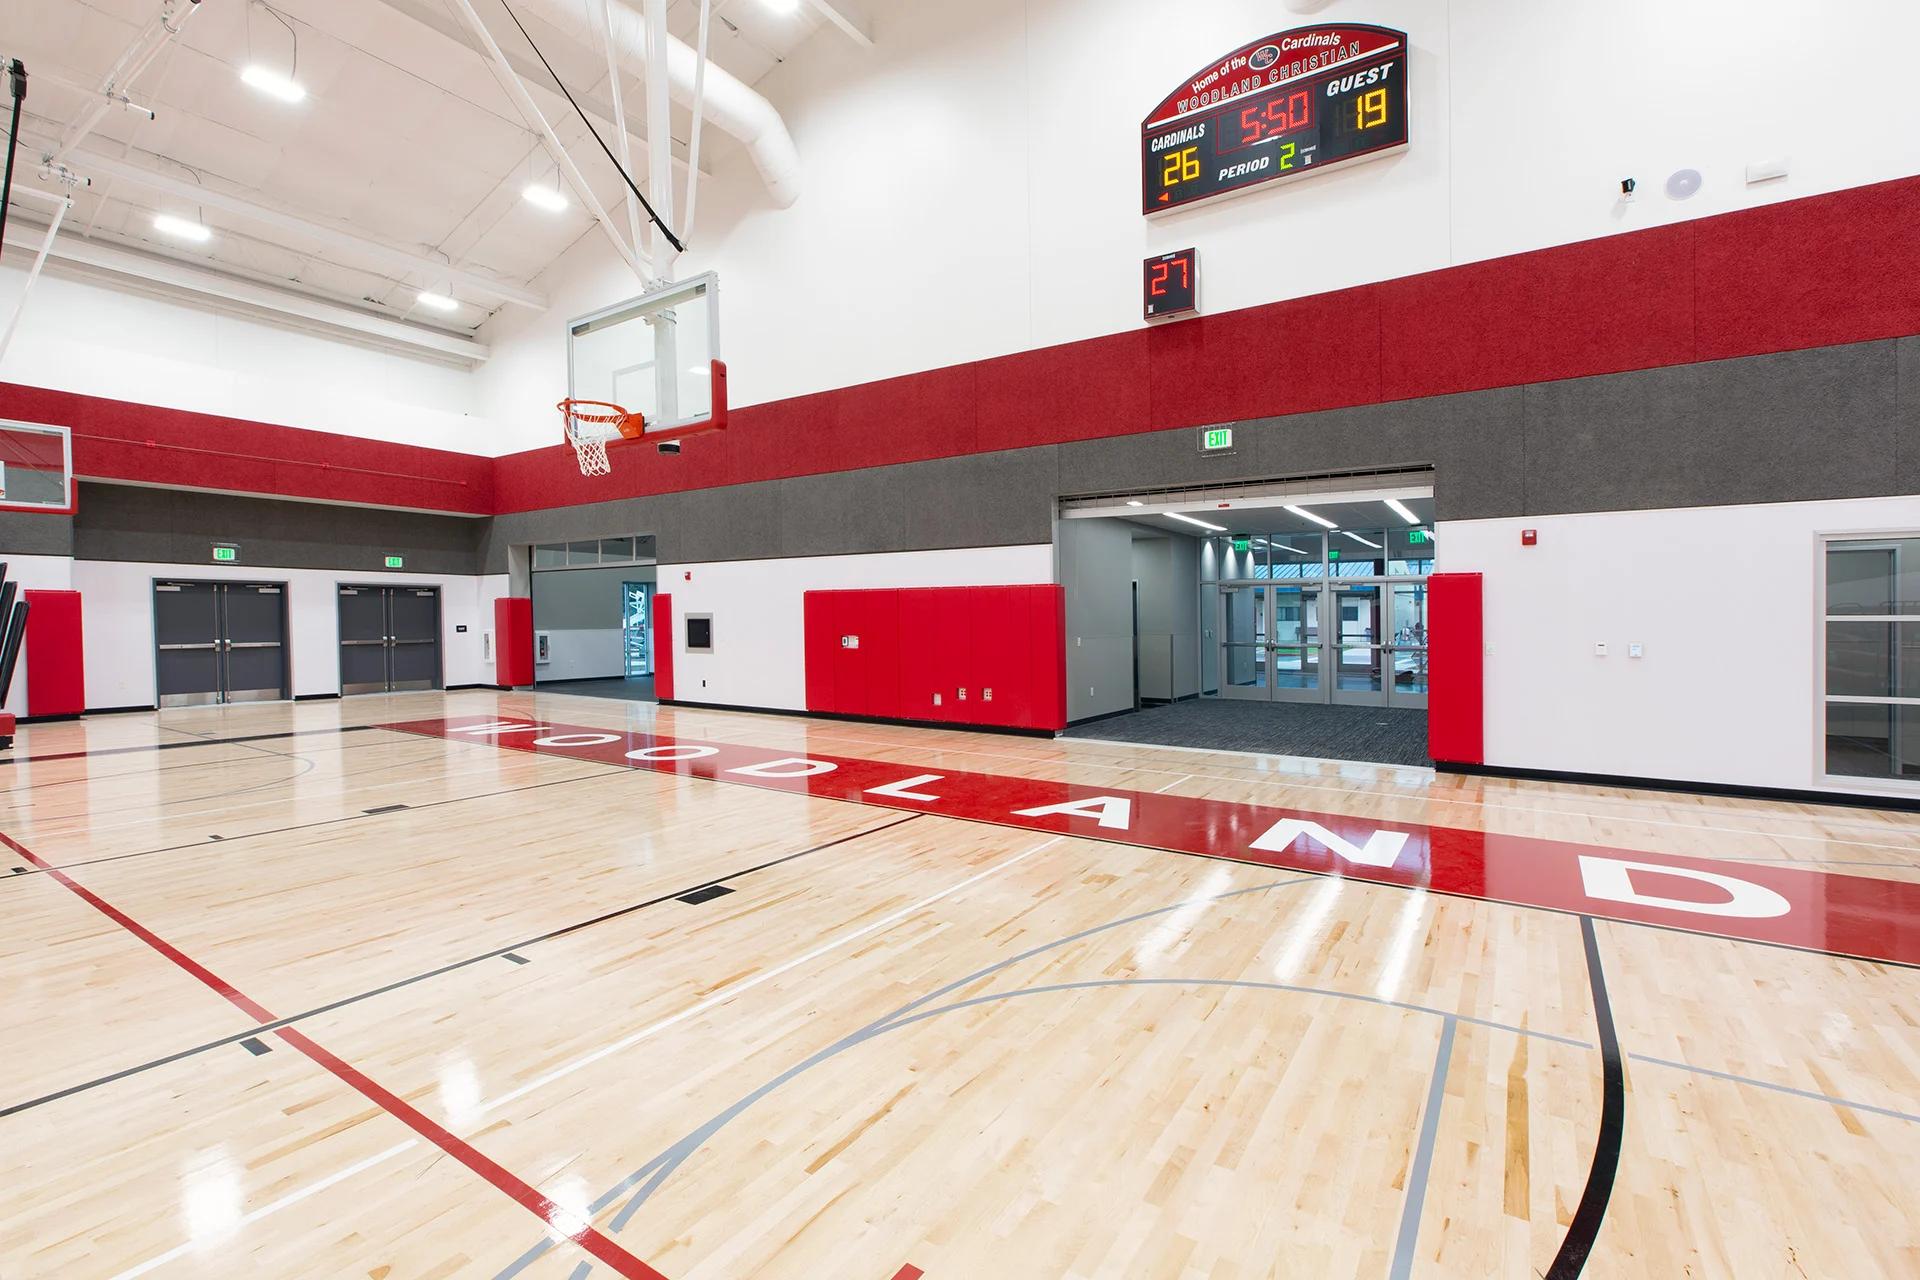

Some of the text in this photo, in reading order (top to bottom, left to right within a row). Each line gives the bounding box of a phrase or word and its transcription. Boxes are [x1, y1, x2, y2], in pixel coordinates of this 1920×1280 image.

[1177, 40, 1360, 113] WOODLAND CHRISTIAN
[1192, 32, 1341, 93] Home of the Cardinals
[1326, 62, 1394, 97] GUEST
[1241, 91, 1308, 143] 5:50
[1357, 87, 1387, 130] 19
[1151, 123, 1205, 152] CARDINALS
[1163, 146, 1199, 187] 26
[1218, 156, 1269, 181] PERIOD
[1280, 142, 1295, 171] 2
[1152, 258, 1187, 296] 27
[1208, 430, 1228, 447] EXIT
[217, 548, 232, 559] EXIT
[1235, 540, 1248, 551] EXIT
[1409, 531, 1425, 543] EXIT
[445, 719, 1792, 918] WOODLAND
